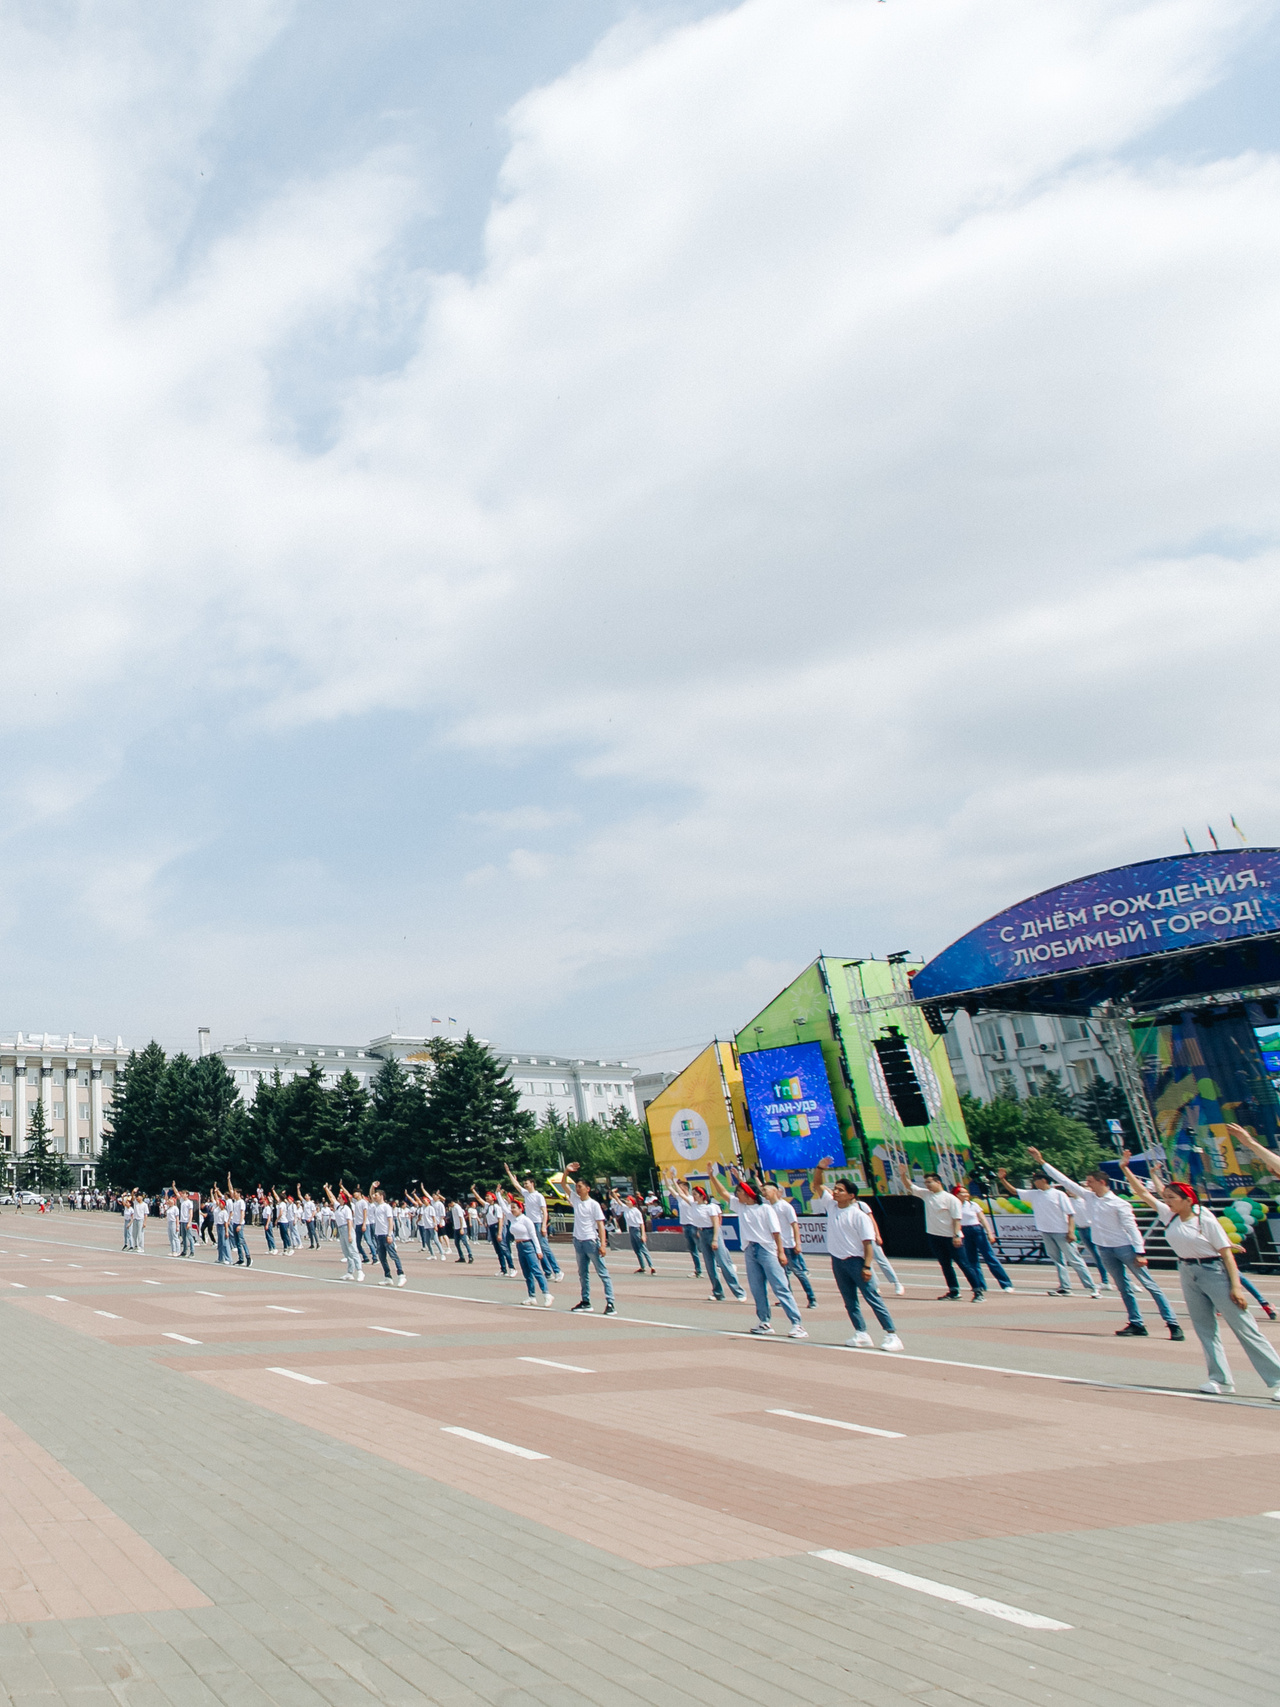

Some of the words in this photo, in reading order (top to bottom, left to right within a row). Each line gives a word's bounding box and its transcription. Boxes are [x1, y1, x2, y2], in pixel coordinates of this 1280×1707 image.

[999, 926, 1016, 942] С
[1020, 908, 1088, 941] ДНЁМ
[1092, 869, 1266, 922] РОЖДЕНИЯ,
[1013, 921, 1147, 966] ЛЮБИМЫЙ
[1152, 899, 1262, 937] ГОРОД!
[764, 1100, 818, 1115] УЛАН-УДЭ
[798, 1223, 827, 1232] РТОЛЕ
[800, 1234, 825, 1243] ССИИ
